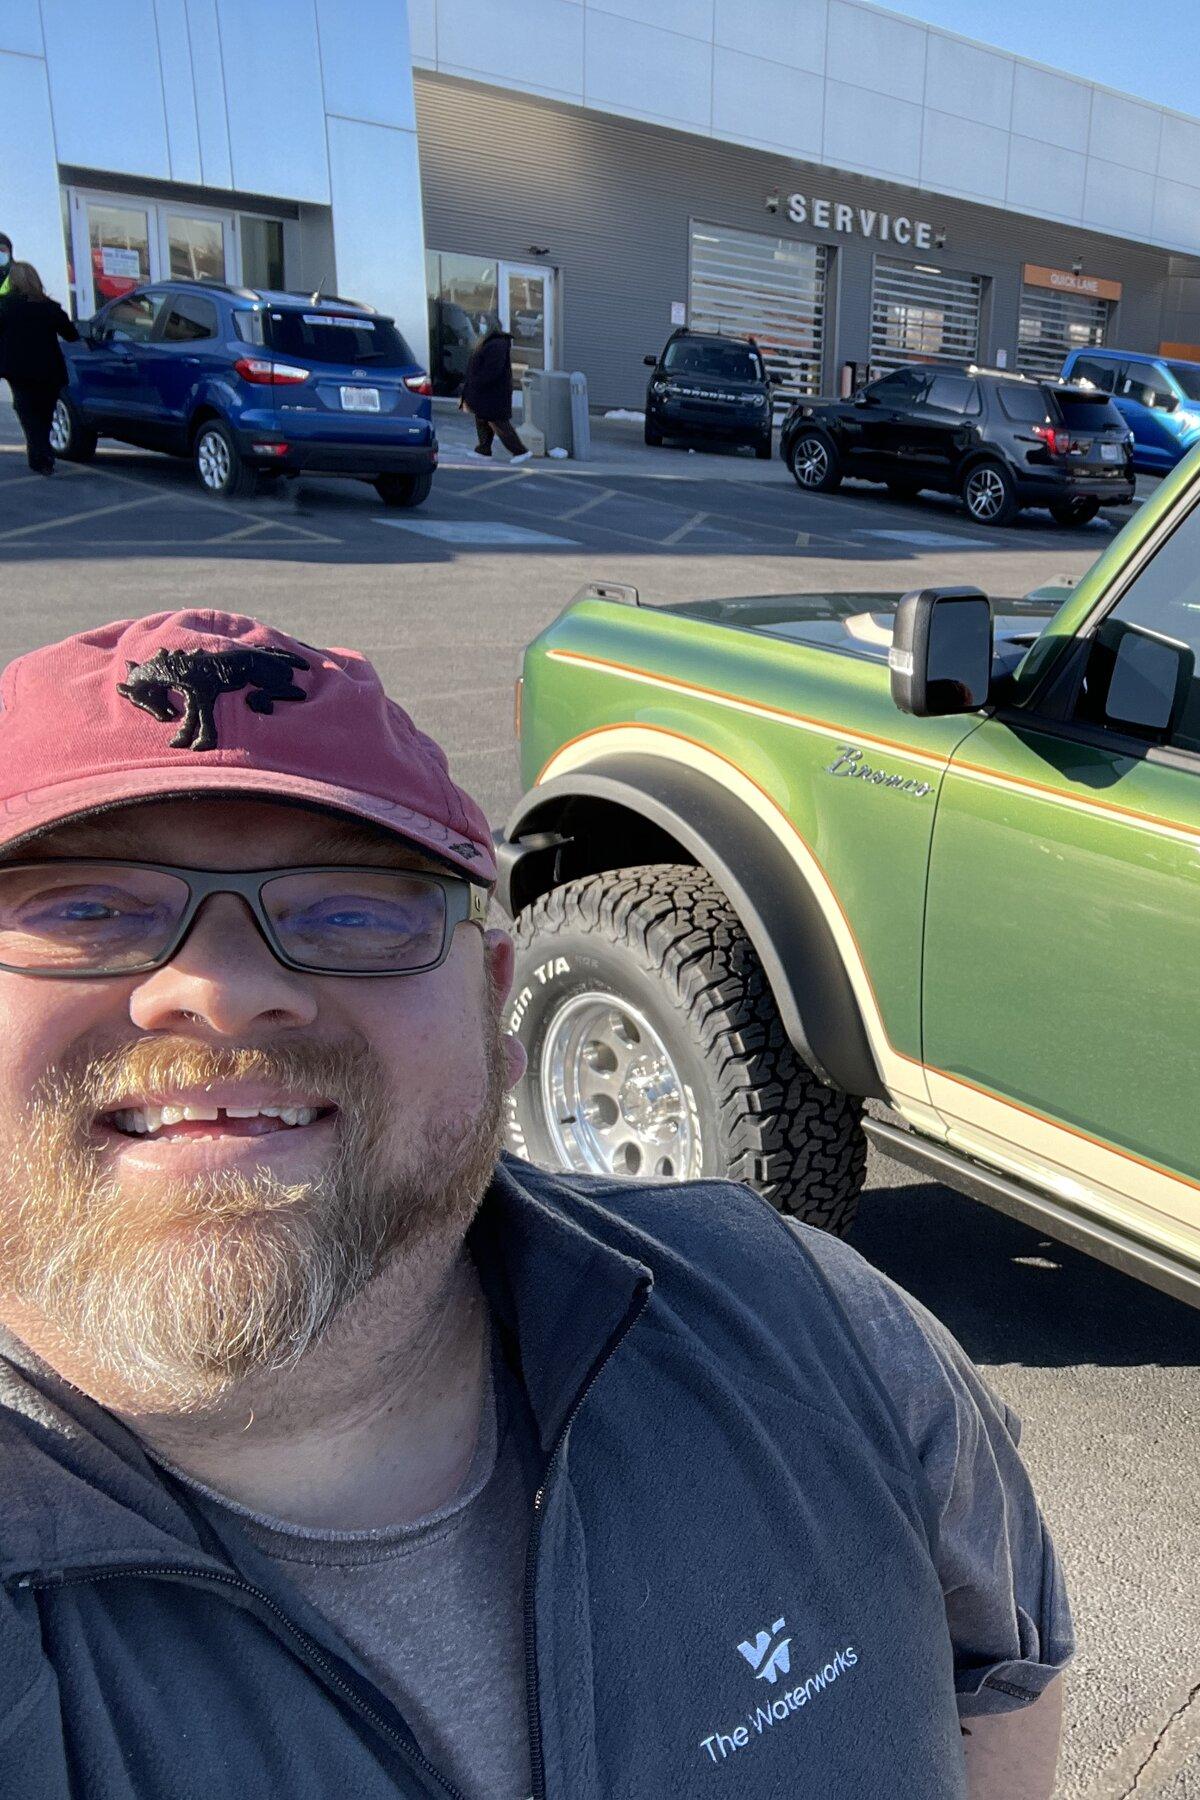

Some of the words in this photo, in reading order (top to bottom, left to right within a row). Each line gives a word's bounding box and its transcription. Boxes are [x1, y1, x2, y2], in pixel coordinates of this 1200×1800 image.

[788, 193, 932, 249] SERVICE
[1050, 272, 1076, 289] QUICK
[1077, 278, 1099, 292] LANE
[826, 746, 936, 797] Bronco
[507, 987, 533, 1035] ain
[533, 956, 571, 985] T/A
[700, 1726, 749, 1763] The
[748, 1647, 858, 1734] Waterworks
